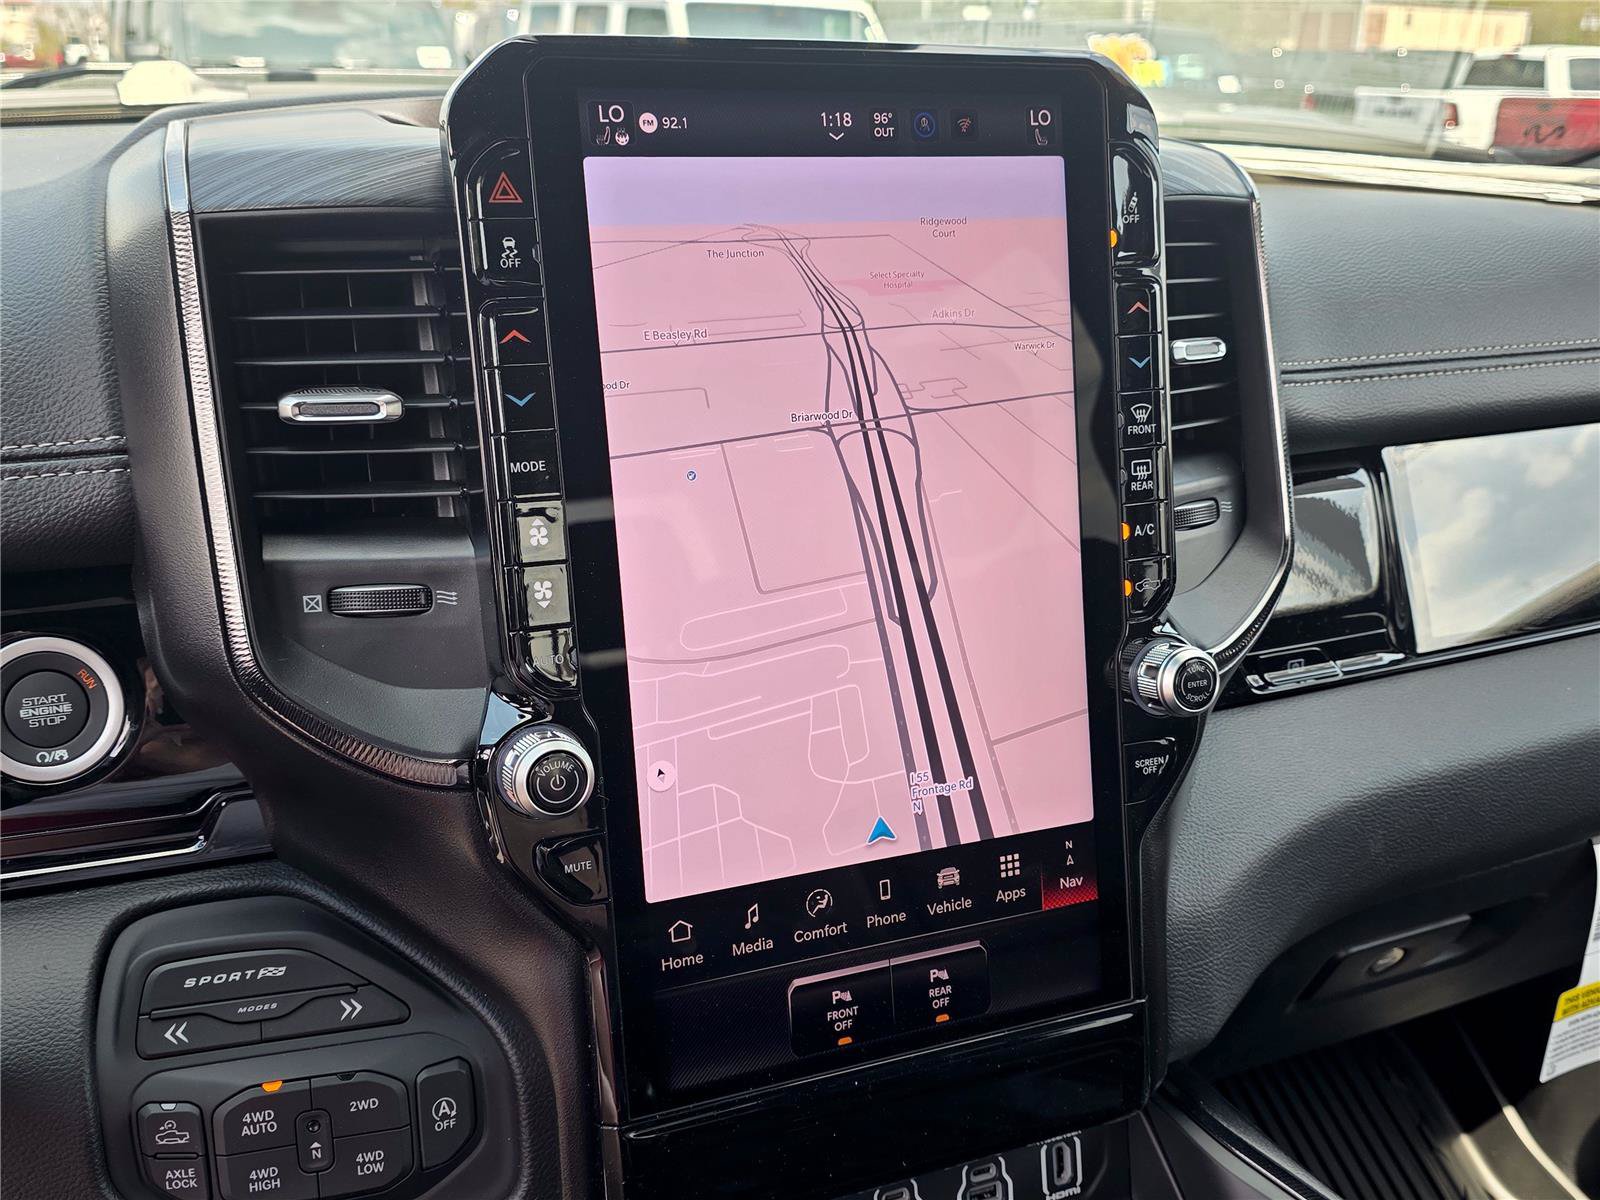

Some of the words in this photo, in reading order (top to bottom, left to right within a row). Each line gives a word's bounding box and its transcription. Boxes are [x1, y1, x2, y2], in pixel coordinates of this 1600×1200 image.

[598, 104, 625, 123] LO
[820, 111, 852, 127] 1:18
[1029, 108, 1052, 127] LO
[642, 119, 654, 127] FM
[662, 116, 688, 129] 92.1
[873, 127, 895, 138] OUT
[920, 216, 967, 227] Ridgewood
[1122, 214, 1140, 224] OFF
[932, 229, 956, 238] Court
[706, 249, 724, 259] The
[726, 249, 765, 258] Junction
[500, 258, 521, 269] OFF
[869, 271, 892, 279] Select
[892, 270, 925, 279] Specialty
[883, 281, 913, 290] Hospital
[932, 309, 962, 319] Adkins
[964, 308, 975, 318] Dr
[643, 331, 650, 341] E
[652, 330, 692, 342] Beasley
[694, 328, 708, 339] Rd
[1014, 341, 1045, 350] Warwick
[1046, 341, 1055, 349] Dr
[619, 380, 630, 390] Dr
[790, 410, 840, 423] Briarwood
[842, 409, 853, 419] Dr
[1127, 423, 1156, 436] FRONT
[510, 460, 547, 473] MODE
[1130, 480, 1154, 492] REAR
[1134, 523, 1155, 537] A/C
[1186, 662, 1206, 675] TUNE
[76, 668, 98, 689] RUN
[1187, 679, 1208, 689] ENTER
[22, 693, 67, 707] START
[1185, 690, 1210, 703] SCROLL
[19, 703, 73, 718] ENGINE
[29, 715, 67, 728] STOP
[537, 759, 575, 778] VOLUME
[1134, 756, 1165, 768] SCREEN
[917, 772, 929, 782] 55
[1142, 765, 1158, 775] OFF
[912, 783, 957, 798] Frontage
[959, 778, 973, 790] Rd
[913, 803, 921, 812] N
[1065, 840, 1073, 849] N
[564, 860, 592, 874] MUTE
[1059, 876, 1084, 889] Nav
[996, 887, 1026, 903] Apps
[927, 897, 972, 916] Vehicle
[866, 911, 907, 928] Phone
[794, 922, 848, 943] Comfort
[732, 938, 774, 957] Media
[661, 953, 704, 971] Home
[183, 969, 256, 988] SPORT
[928, 985, 952, 999] REAR
[237, 1002, 278, 1014] MODES
[932, 997, 950, 1009] OFF
[827, 1005, 859, 1022] FRONT
[834, 1019, 853, 1032] OFF
[349, 1098, 379, 1113] 2WD
[242, 1109, 275, 1124] 4WD
[241, 1120, 277, 1137] AUTO
[434, 1117, 457, 1132] OFF
[312, 1148, 322, 1160] N
[356, 1149, 384, 1164] 4WD
[165, 1167, 196, 1181] AXLE
[249, 1166, 279, 1181] 4WD
[356, 1161, 385, 1176] LOW
[166, 1176, 198, 1190] LOCK
[249, 1177, 281, 1193] HIGH
